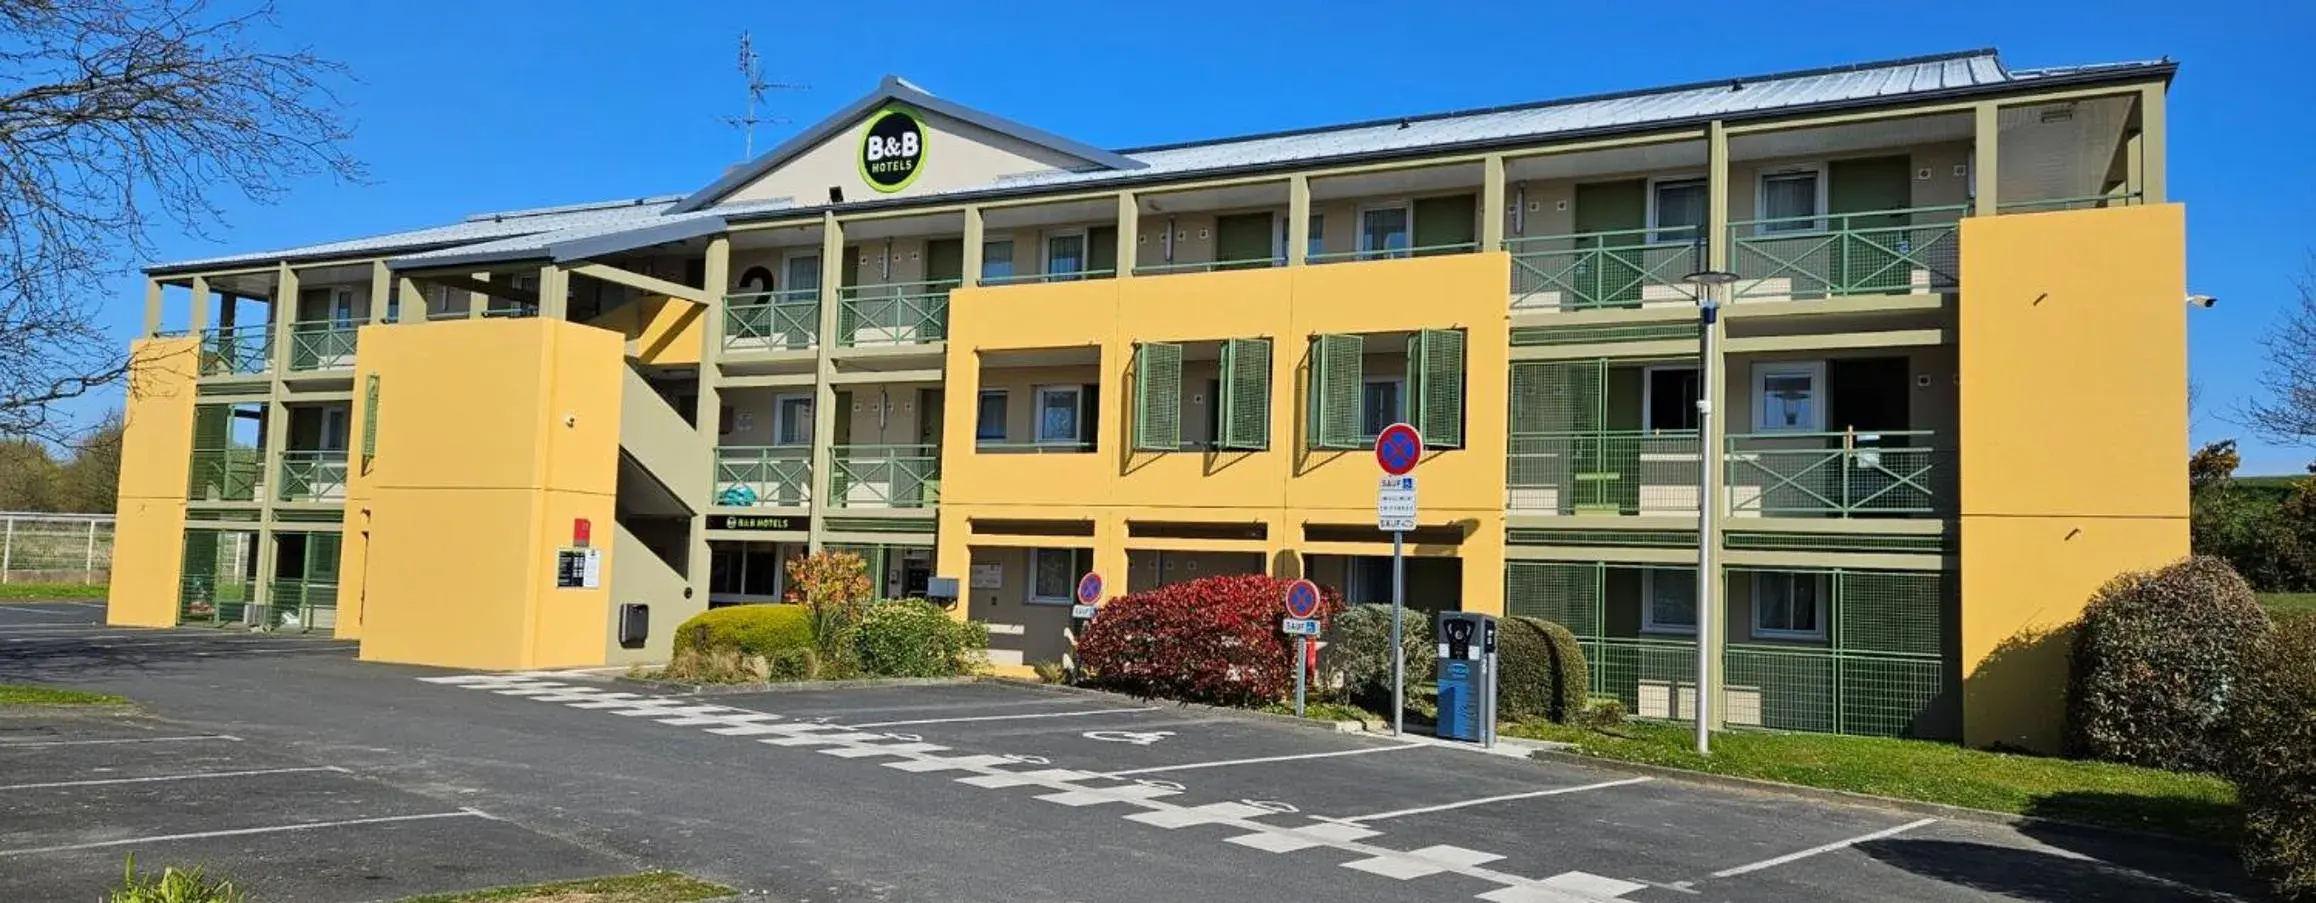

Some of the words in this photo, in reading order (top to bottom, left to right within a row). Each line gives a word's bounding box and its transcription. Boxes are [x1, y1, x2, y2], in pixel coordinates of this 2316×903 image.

[868, 131, 919, 161] B&B
[872, 160, 912, 173] HOTELS
[738, 264, 774, 338] 2
[1381, 479, 1401, 487] SAUF
[757, 518, 788, 529] HOTELS
[1380, 519, 1400, 528] SAUF
[1286, 621, 1305, 630] SAUF
